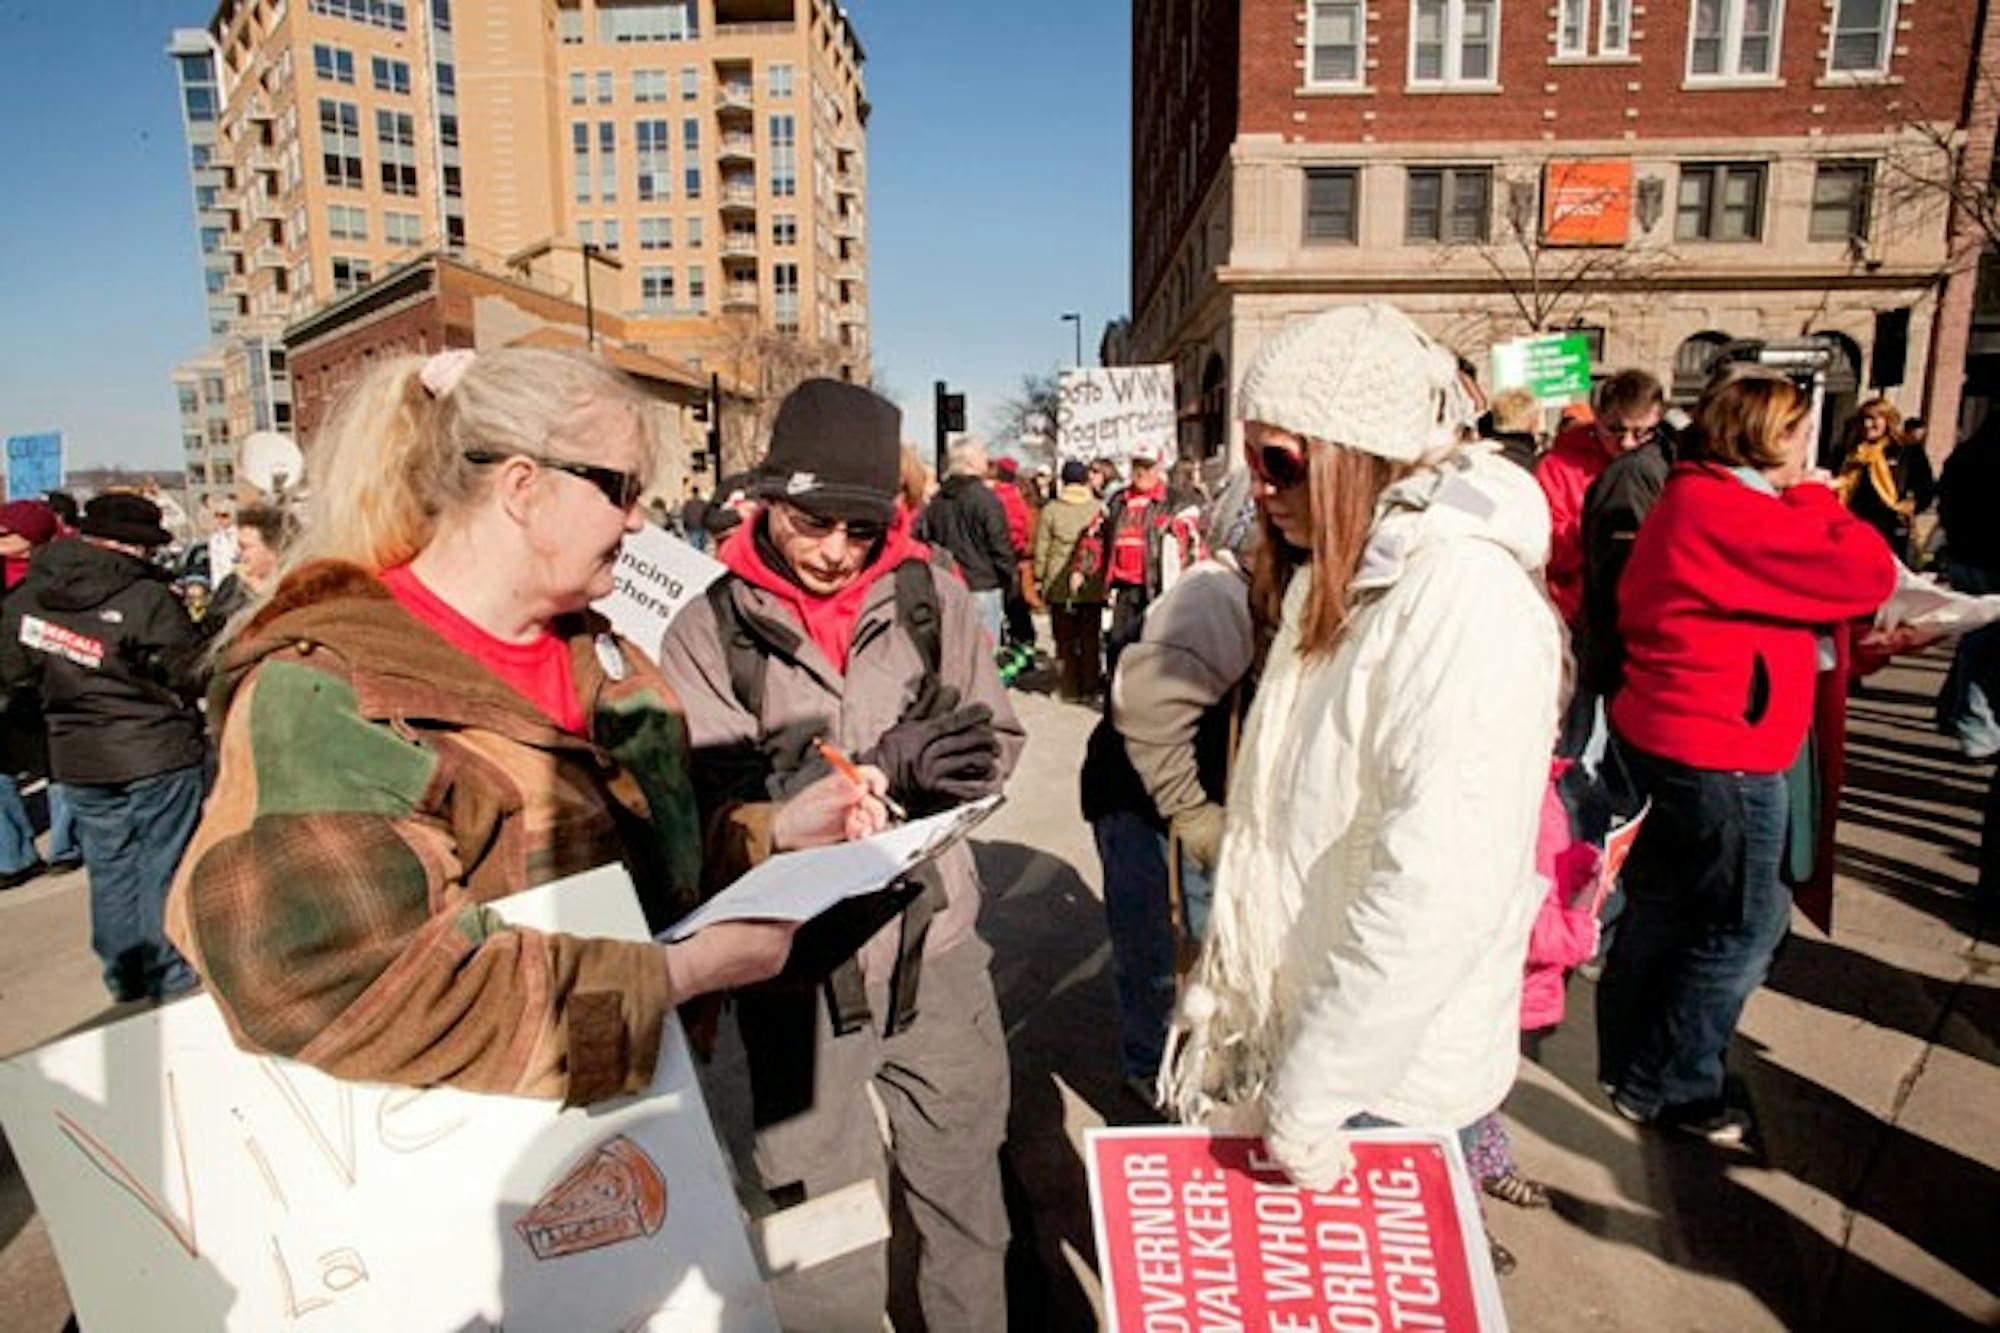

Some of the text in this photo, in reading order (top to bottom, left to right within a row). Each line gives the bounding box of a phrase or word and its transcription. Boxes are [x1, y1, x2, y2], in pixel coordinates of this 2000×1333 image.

[612, 577, 670, 618] chers
[621, 552, 684, 600] ncing
[1366, 1158, 1446, 1333] TCHING.
